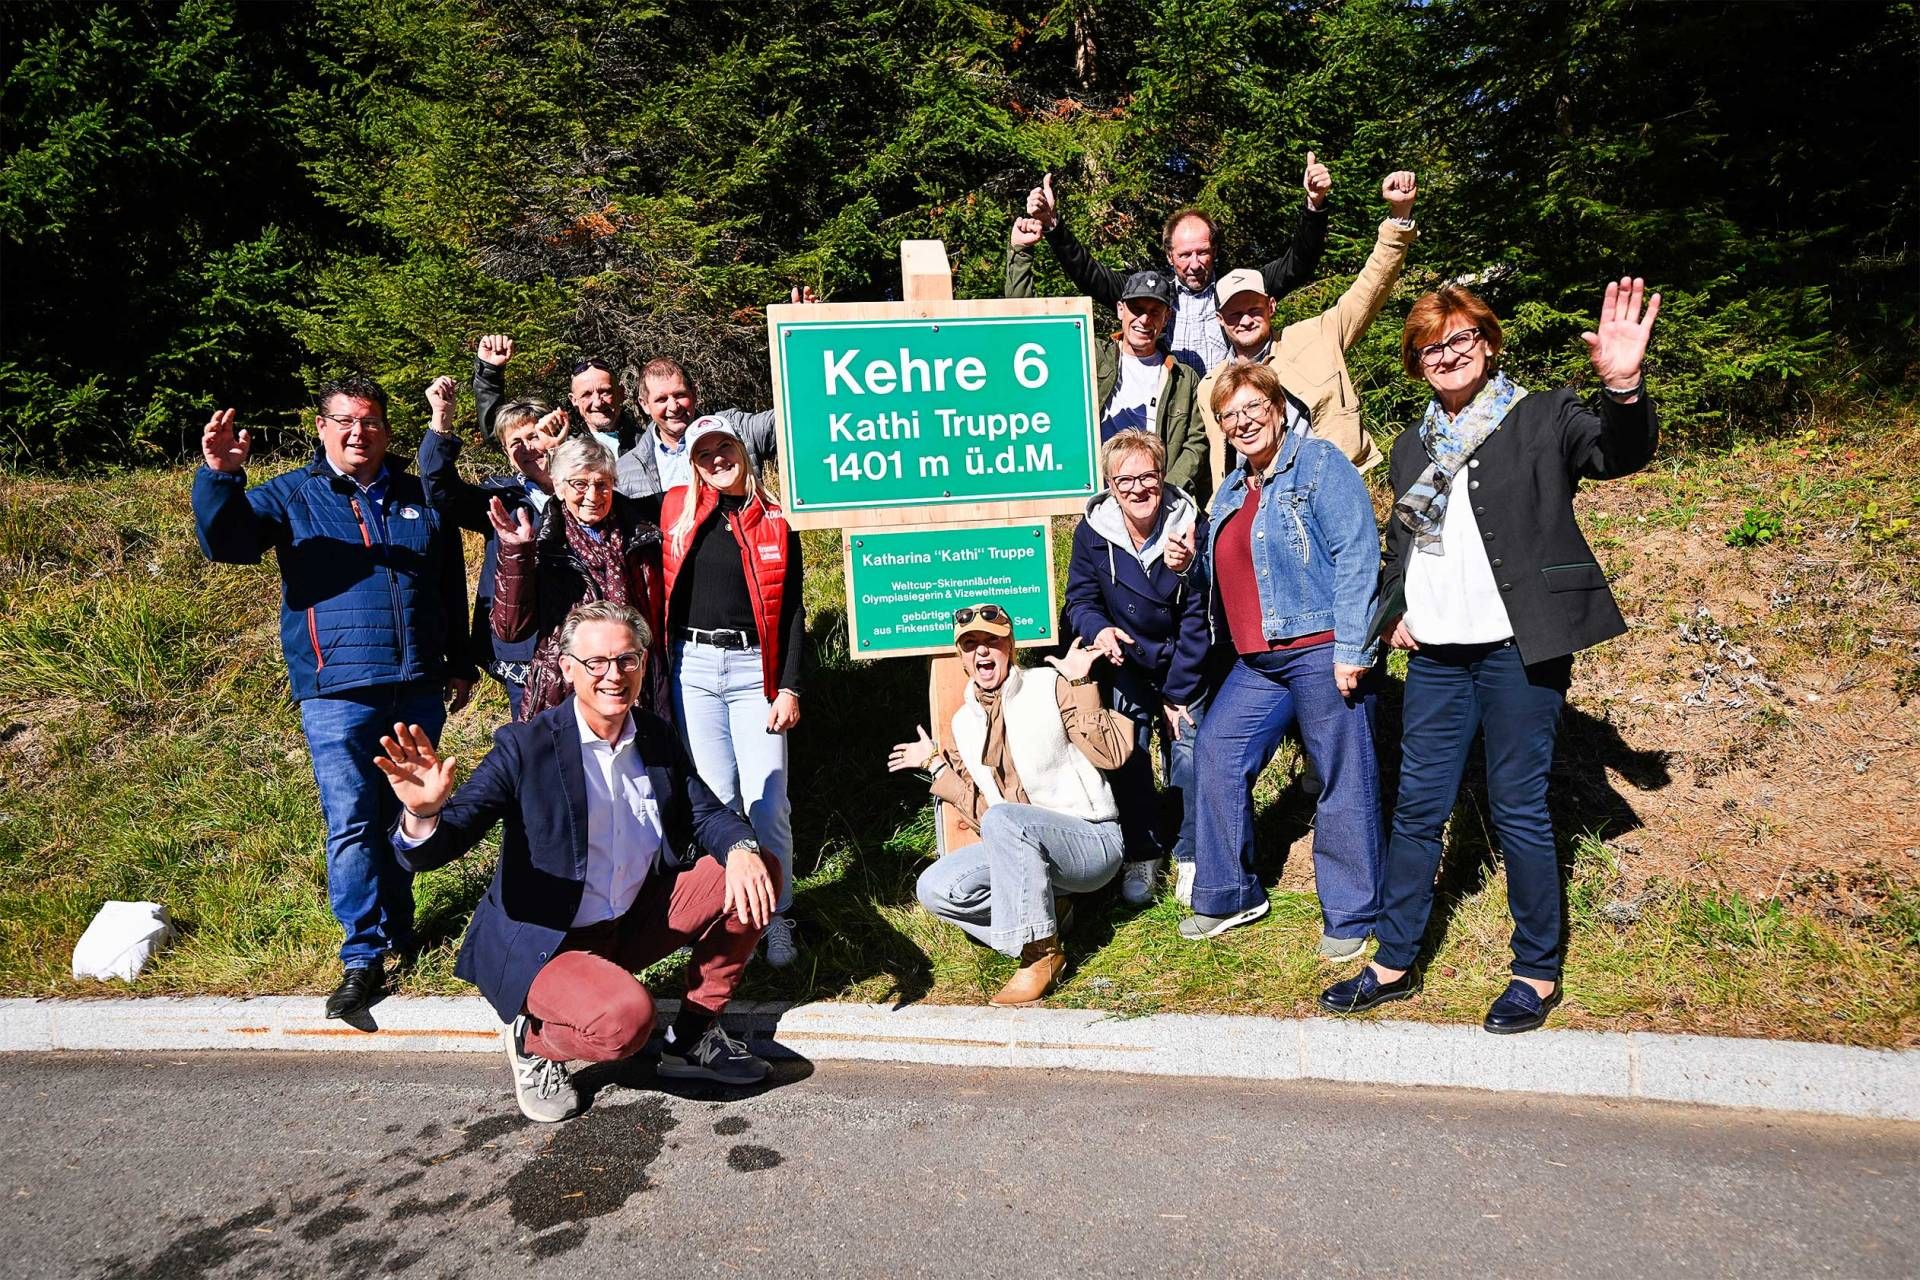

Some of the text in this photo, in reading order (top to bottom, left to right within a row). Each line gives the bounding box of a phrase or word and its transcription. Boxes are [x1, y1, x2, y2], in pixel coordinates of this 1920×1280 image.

[823, 342, 1049, 396] Kehre 6
[829, 408, 1051, 442] Kathi Truppe
[823, 443, 1063, 482] 1401 m ü.d.M.
[862, 552, 931, 567] Katharina
[987, 546, 1035, 561] Truppe
[891, 576, 1012, 591] Weltcup-Skirennläuferin
[862, 584, 1041, 605] Olympiasiegerin & Vizeweltmeisterin
[873, 615, 1034, 635] aus Finkenstein See
[901, 610, 951, 624] gebürtige
